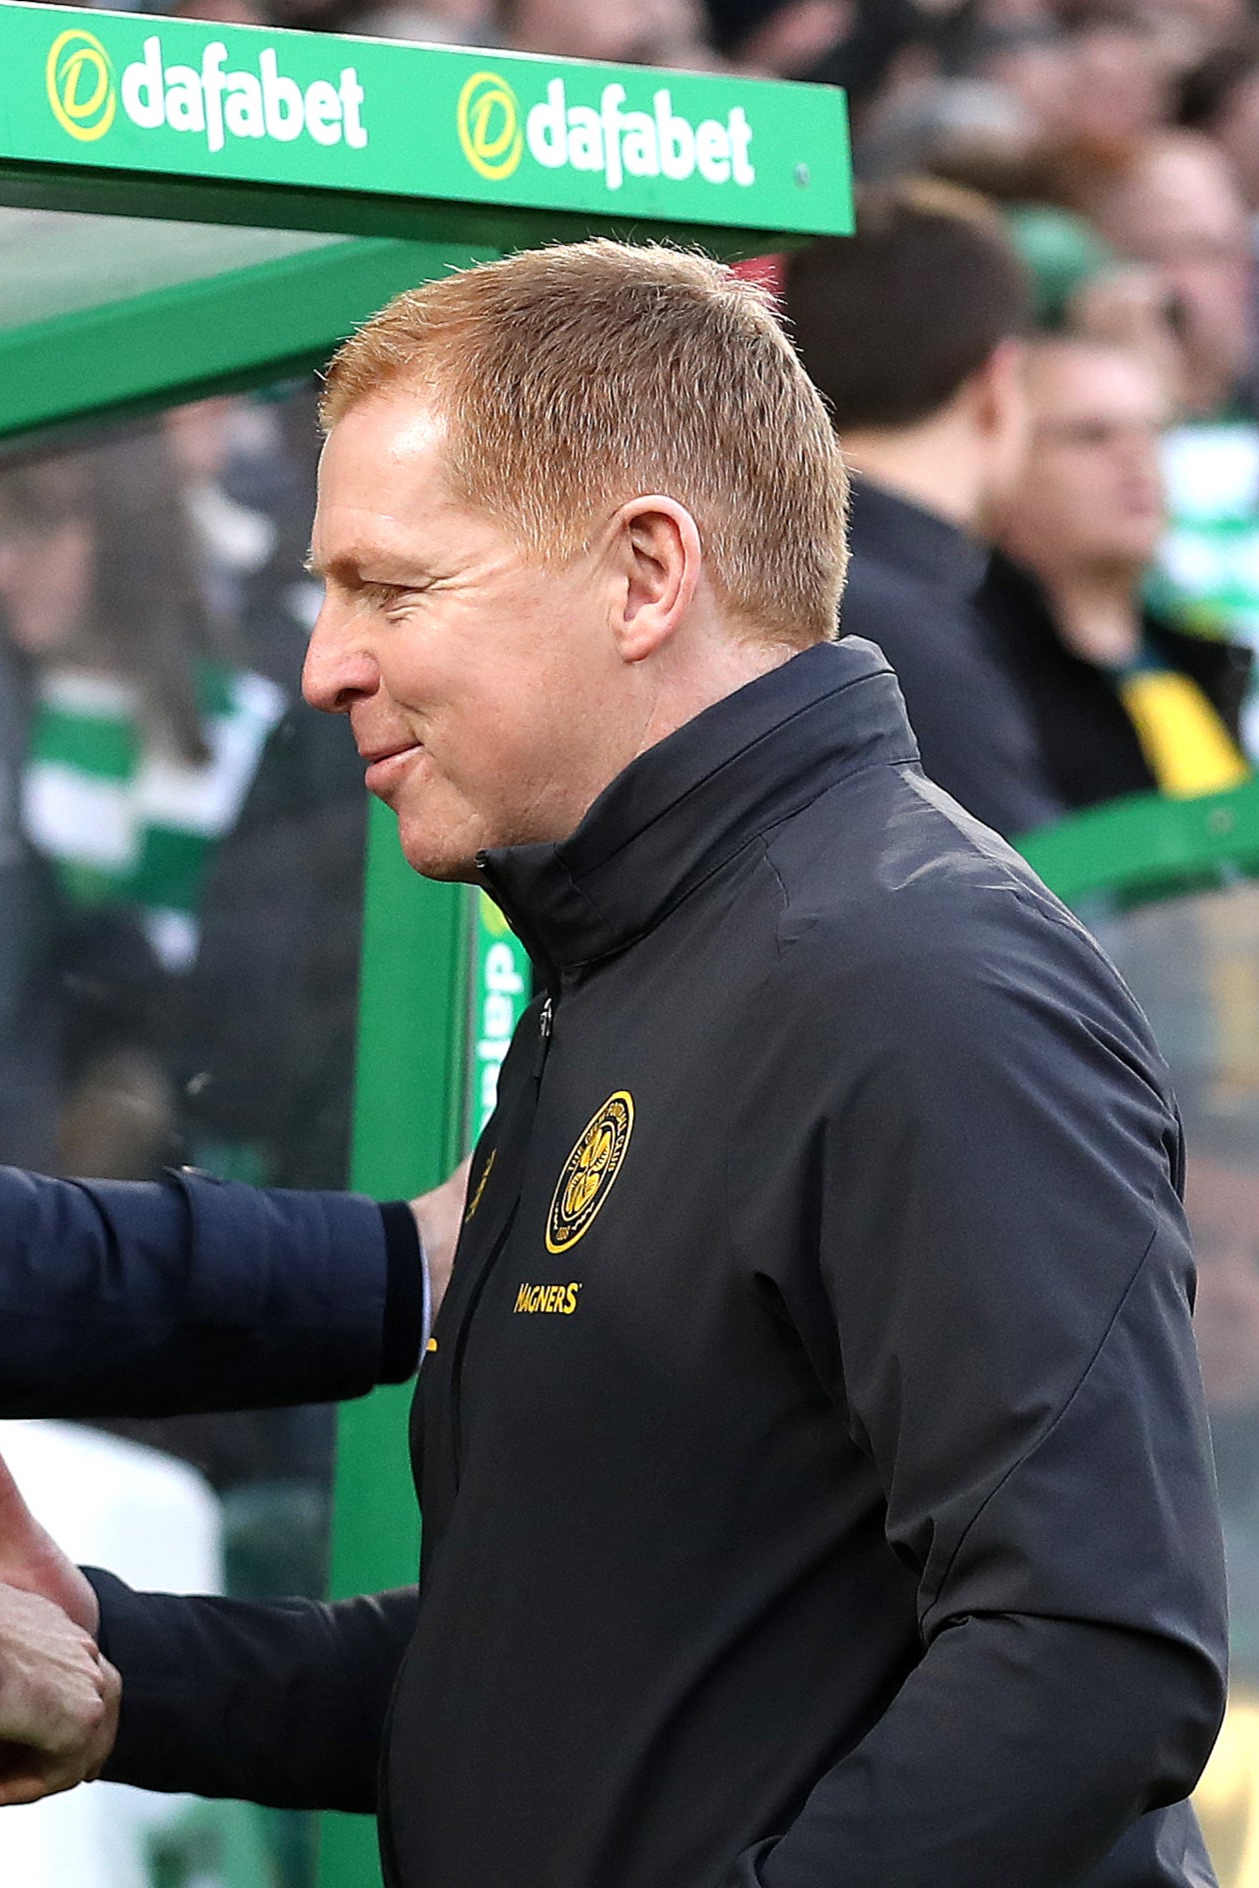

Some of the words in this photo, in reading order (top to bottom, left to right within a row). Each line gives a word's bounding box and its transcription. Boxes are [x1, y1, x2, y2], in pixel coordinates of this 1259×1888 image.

[121, 35, 369, 153] dafabet
[526, 77, 756, 190] dafabet
[513, 1282, 579, 1315] MAGNERS
